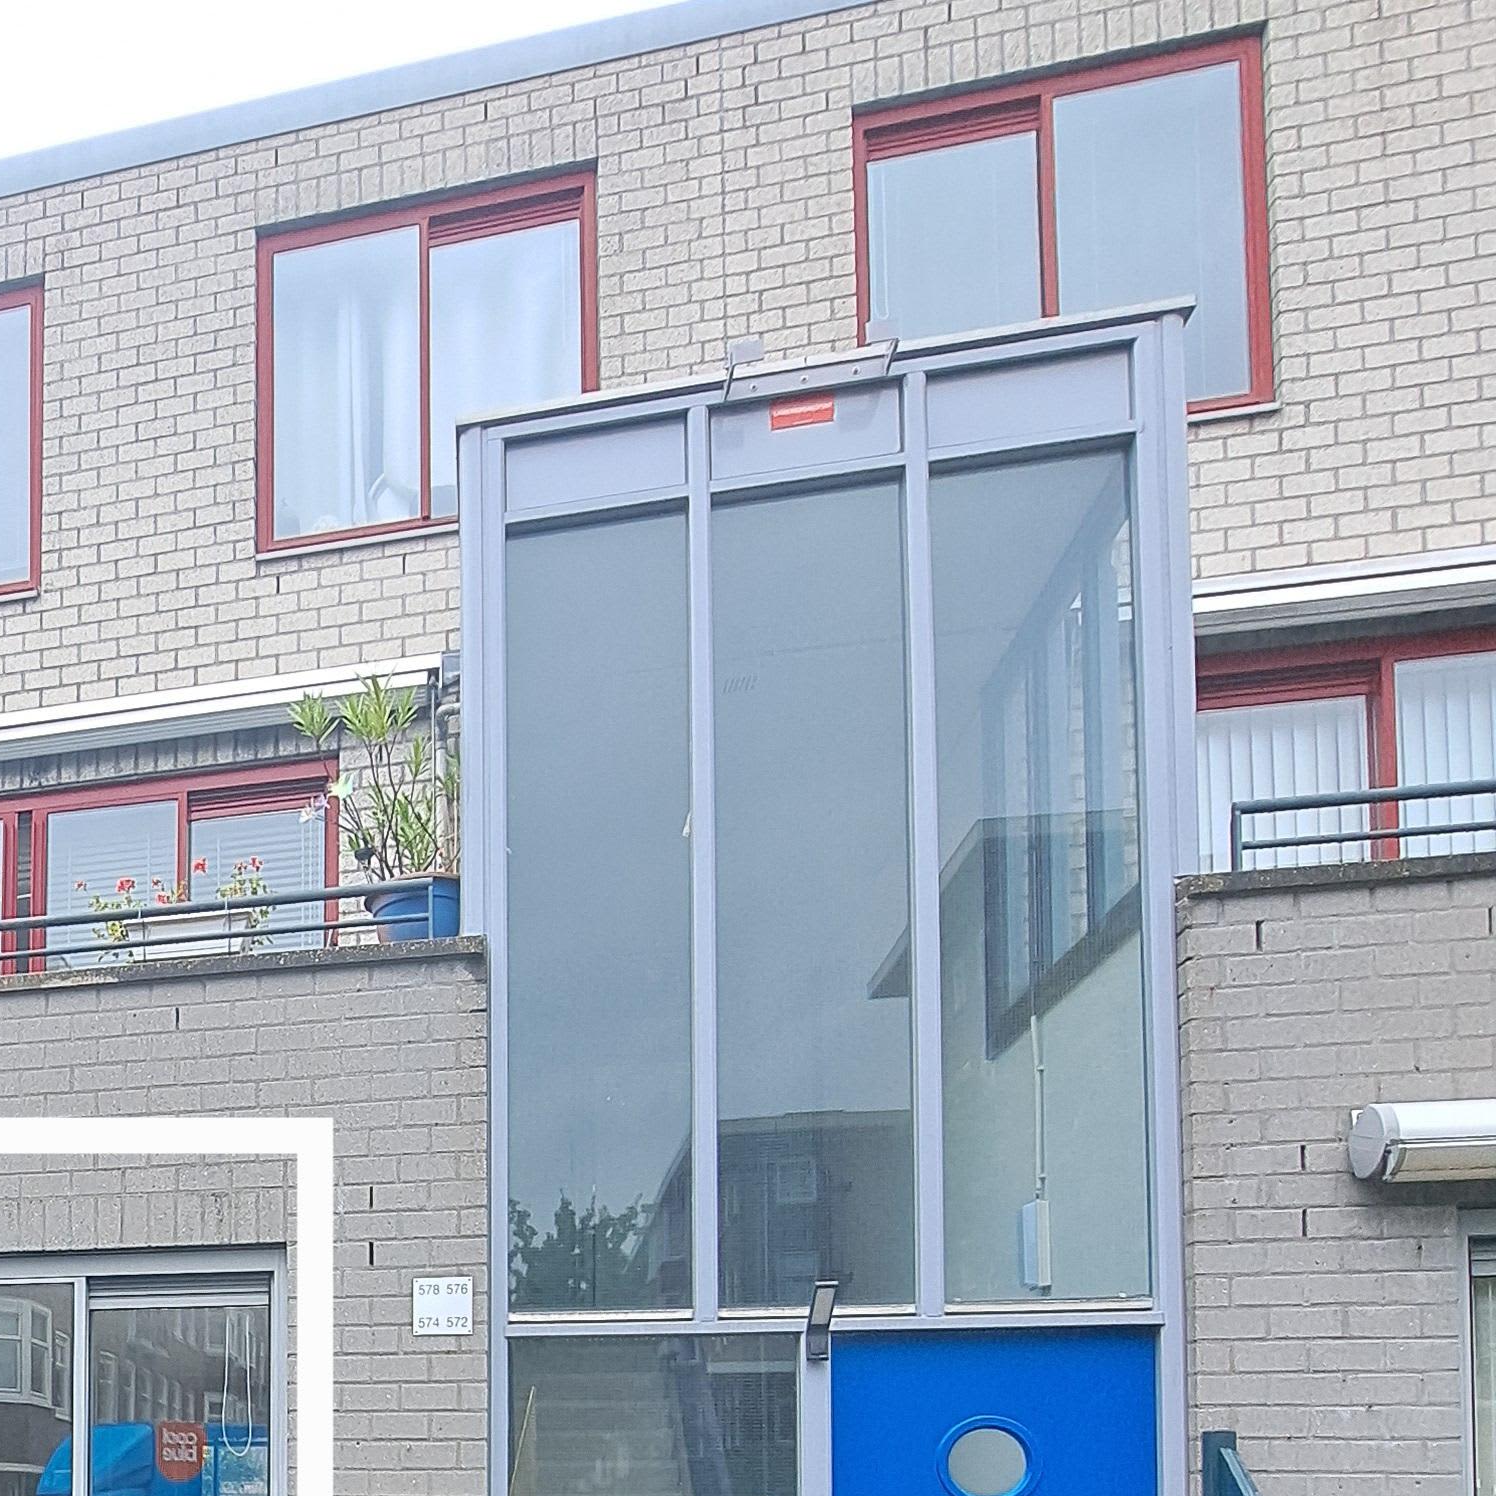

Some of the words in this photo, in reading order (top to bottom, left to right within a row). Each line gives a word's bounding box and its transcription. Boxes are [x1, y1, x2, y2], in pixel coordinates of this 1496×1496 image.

[418, 1284, 440, 1296] 578
[446, 1283, 468, 1295] 576
[418, 1317, 440, 1328] 574
[446, 1316, 468, 1328] 572
